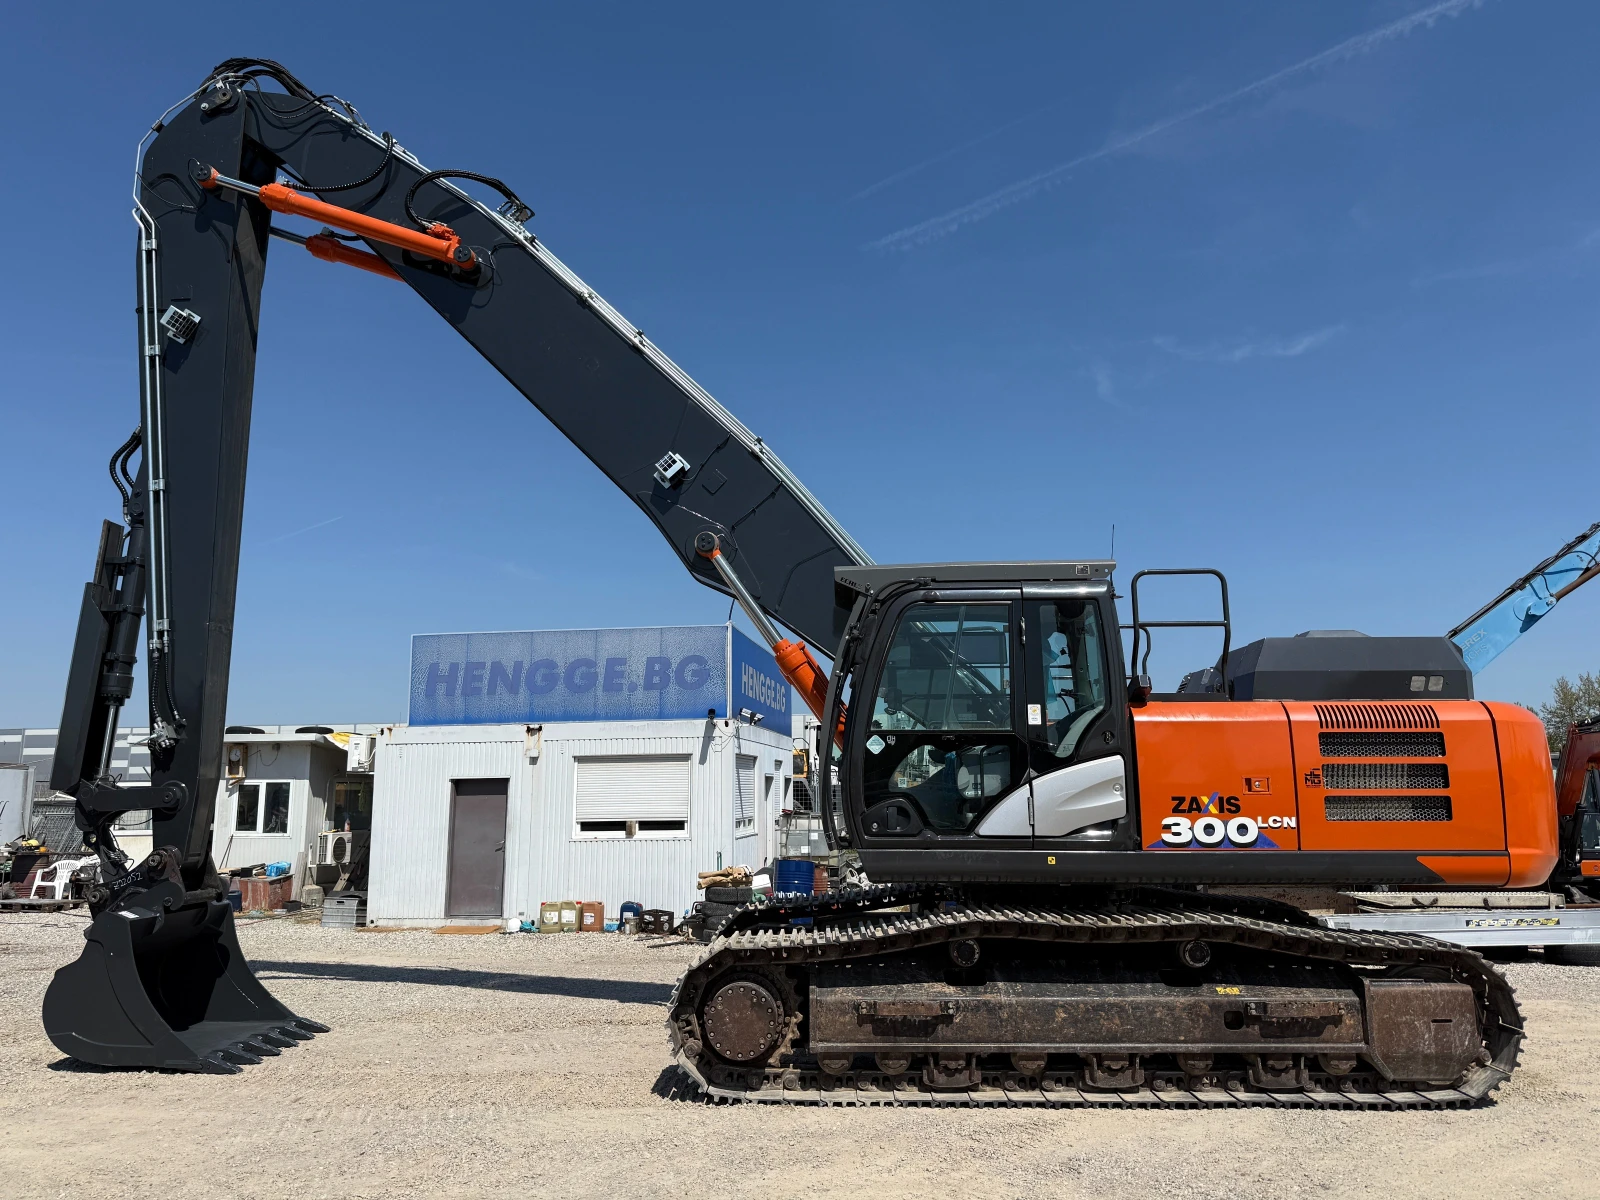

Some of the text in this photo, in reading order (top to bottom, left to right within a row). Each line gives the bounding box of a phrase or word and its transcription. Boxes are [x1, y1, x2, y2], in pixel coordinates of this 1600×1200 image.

[1460, 628, 1487, 651] EREX
[1464, 643, 1488, 664] UCHS
[425, 654, 711, 698] HENGGE.BG
[741, 661, 786, 713] HENGGE.BG
[1171, 792, 1242, 814] ZAXIS
[1161, 815, 1297, 848] 300 LCN
